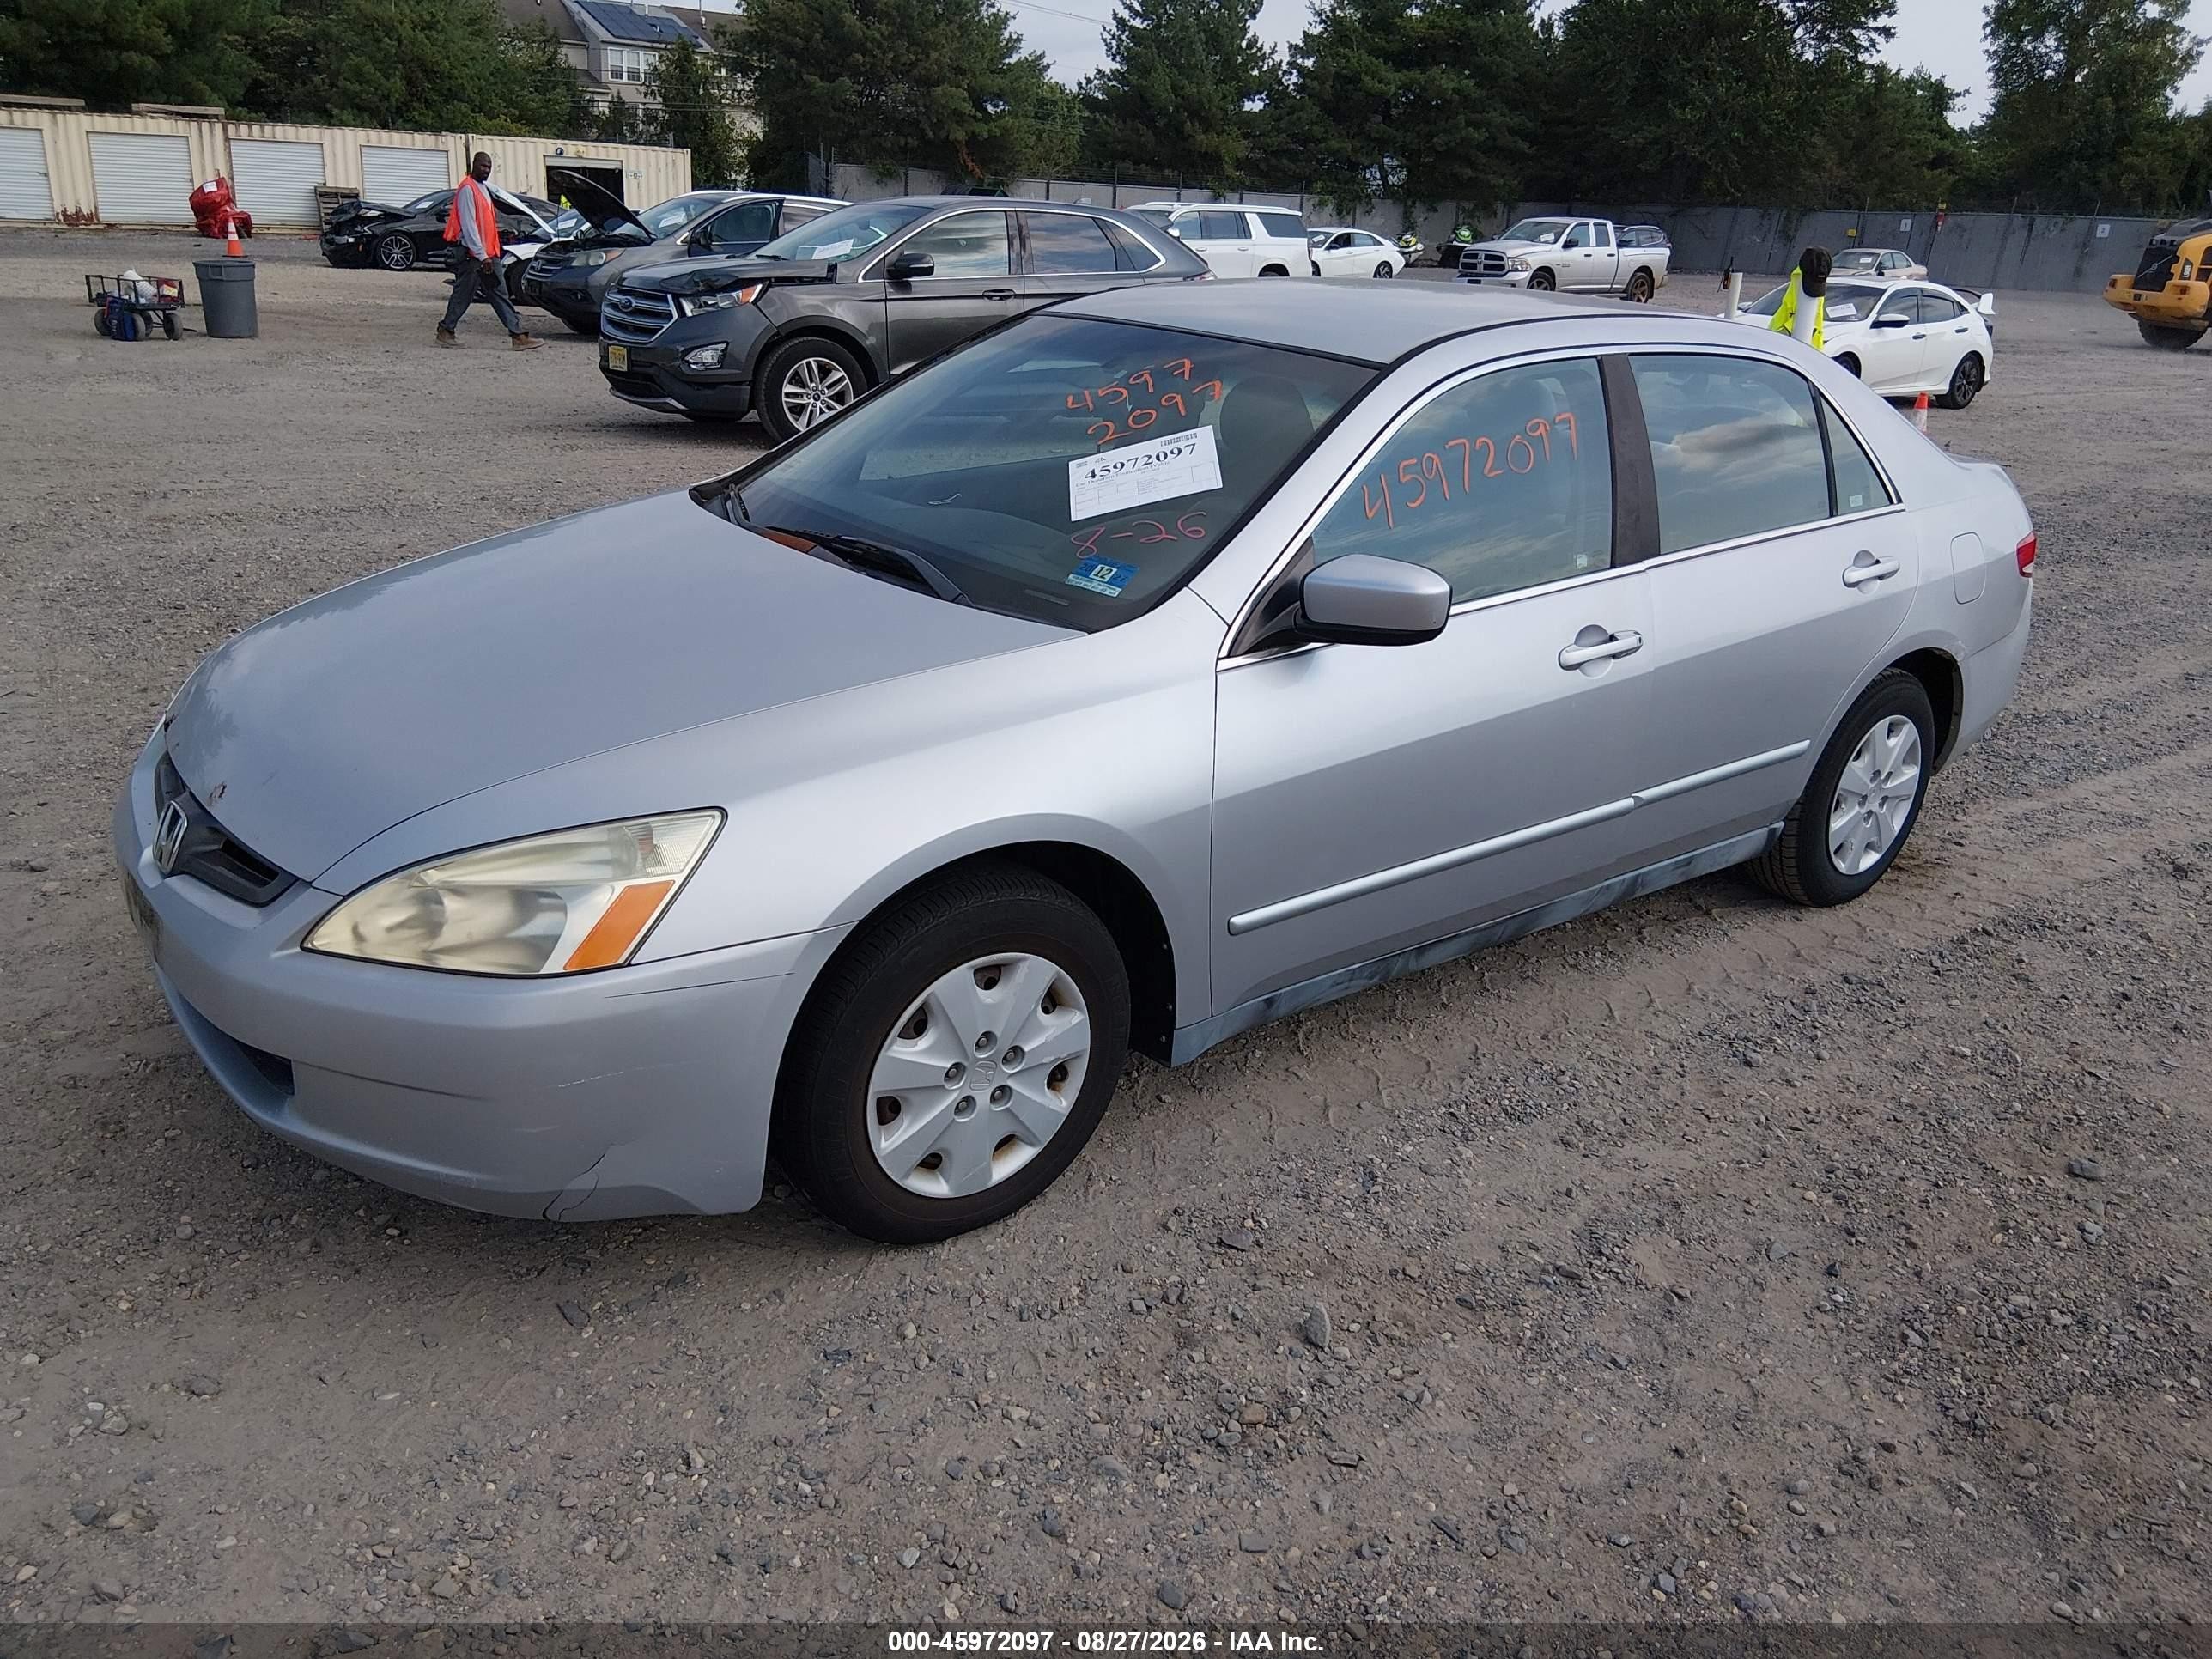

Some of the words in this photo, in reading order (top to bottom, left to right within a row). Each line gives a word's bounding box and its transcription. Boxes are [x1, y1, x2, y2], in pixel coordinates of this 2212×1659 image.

[1066, 357, 1194, 412] 4597
[1086, 380, 1223, 445] 2097
[1084, 442, 1196, 480] 45972097
[1361, 412, 1578, 530] 45972097
[1070, 512, 1207, 559] 8-26
[1093, 566, 1114, 580] 12
